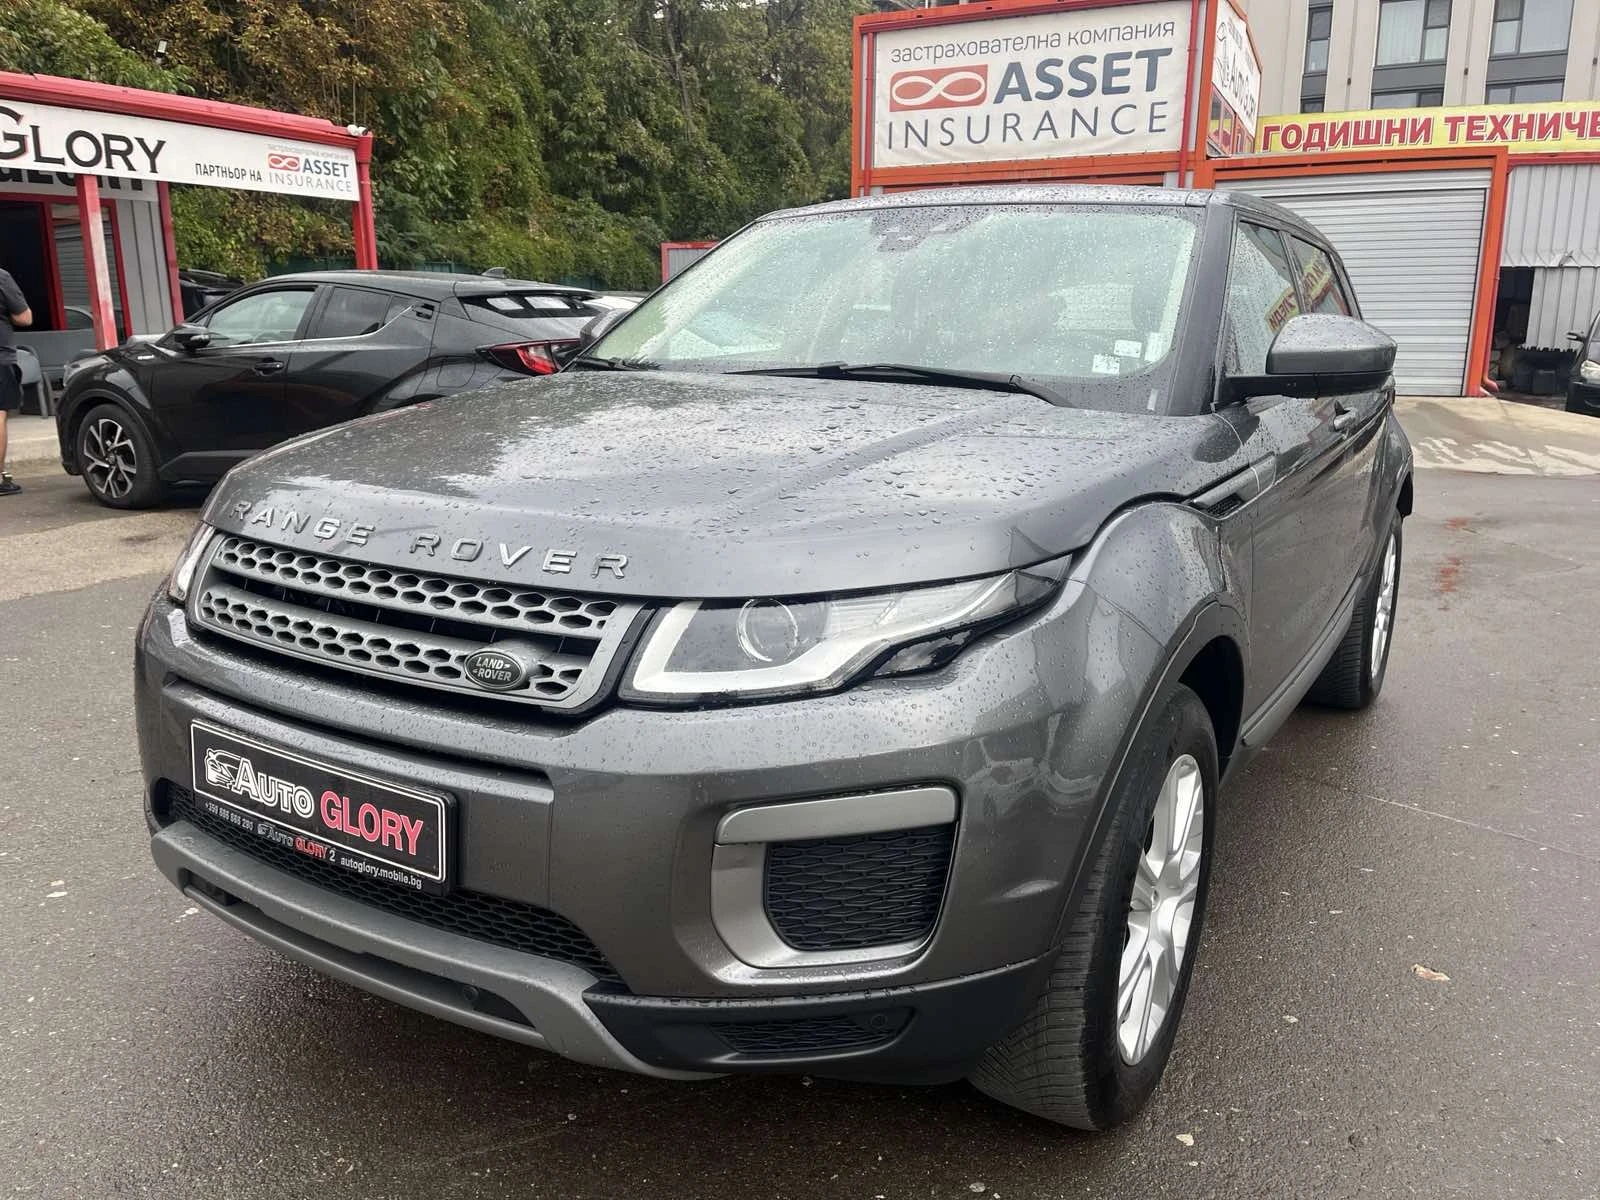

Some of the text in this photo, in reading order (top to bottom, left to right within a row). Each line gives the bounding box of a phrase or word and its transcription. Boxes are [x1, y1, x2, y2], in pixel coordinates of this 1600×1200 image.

[890, 20, 1176, 65] застрахователна компания
[993, 47, 1174, 105] ASSET
[888, 101, 1169, 150] INSURANCE
[1262, 116, 1434, 153] ГОДИШНИ
[195, 163, 263, 182] ПАРТНЬОР НА
[268, 172, 352, 192] INSURANCE
[302, 158, 349, 178] ASSET
[229, 501, 629, 580] RANGE ROVER
[476, 656, 504, 670] LAND
[477, 668, 512, 682] ROVER
[233, 757, 424, 856] AUTO GLORY
[294, 836, 329, 860] GLORY
[328, 849, 336, 862] 2
[340, 857, 422, 890] autoglory.mobile.bg
